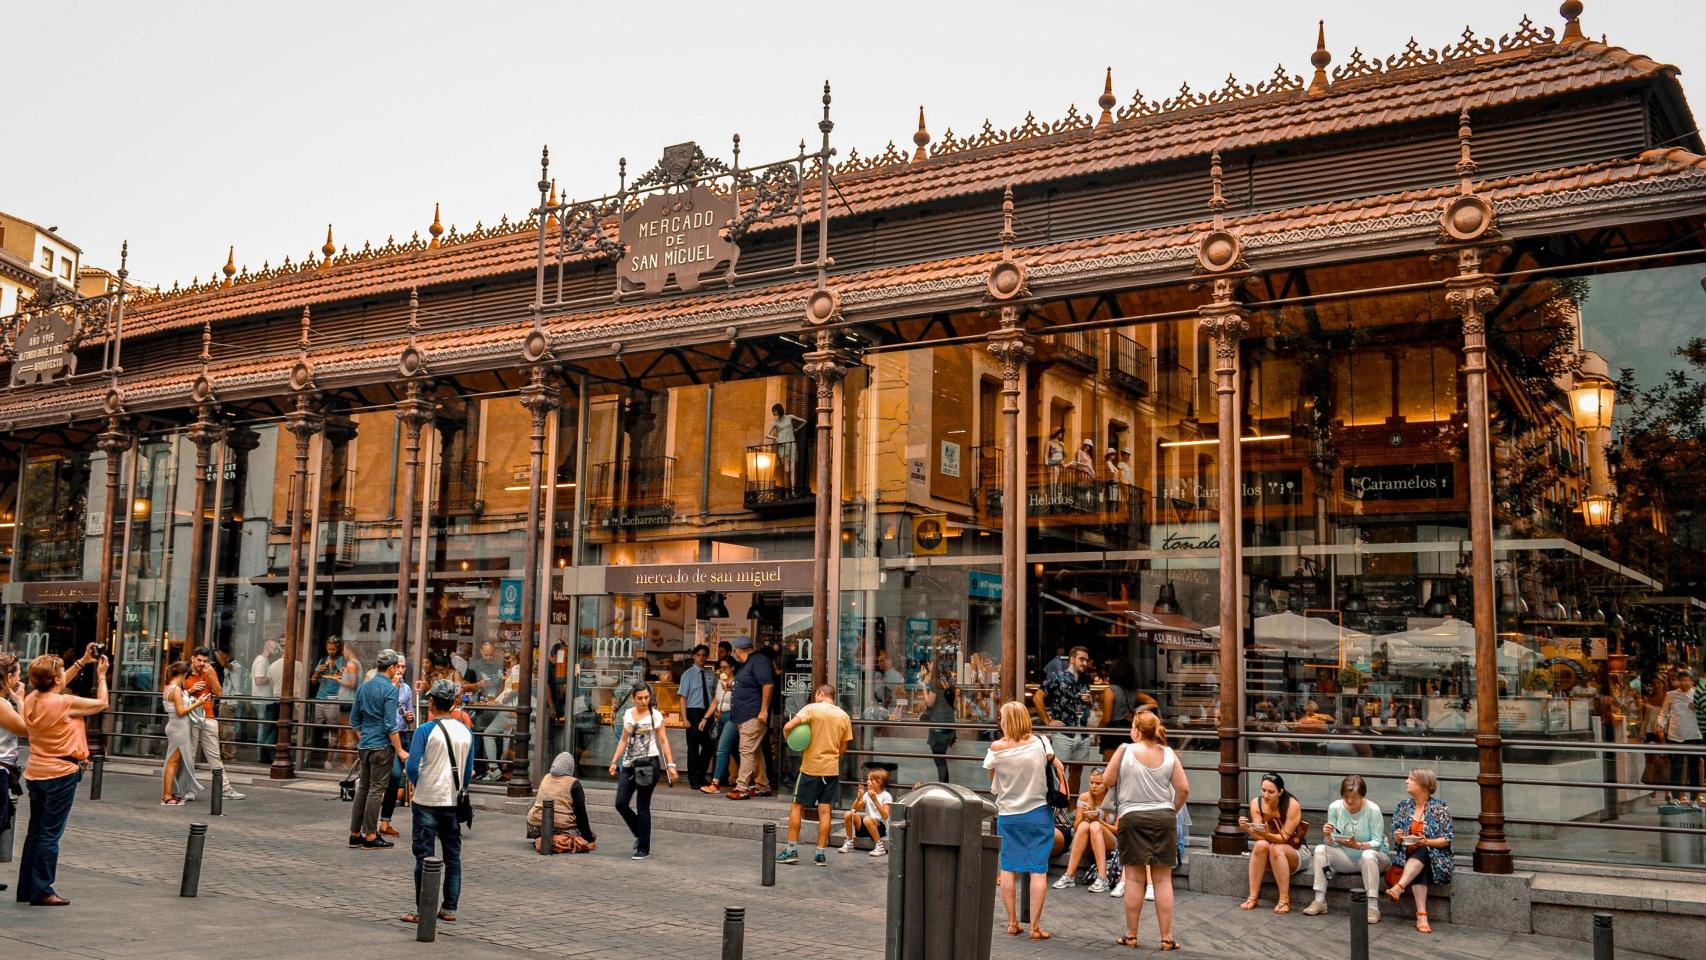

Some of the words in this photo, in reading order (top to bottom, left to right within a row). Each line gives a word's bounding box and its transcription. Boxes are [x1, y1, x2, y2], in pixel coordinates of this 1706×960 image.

[639, 210, 714, 238] MERCADO
[666, 234, 685, 247] DE
[631, 253, 658, 272] SAN
[664, 244, 715, 267] MIGUEL
[1360, 475, 1437, 491] Caramelos
[1029, 492, 1074, 506] Helados
[635, 568, 689, 584] mercado
[692, 568, 707, 583] de
[710, 571, 733, 583] san
[736, 565, 782, 587] miguel
